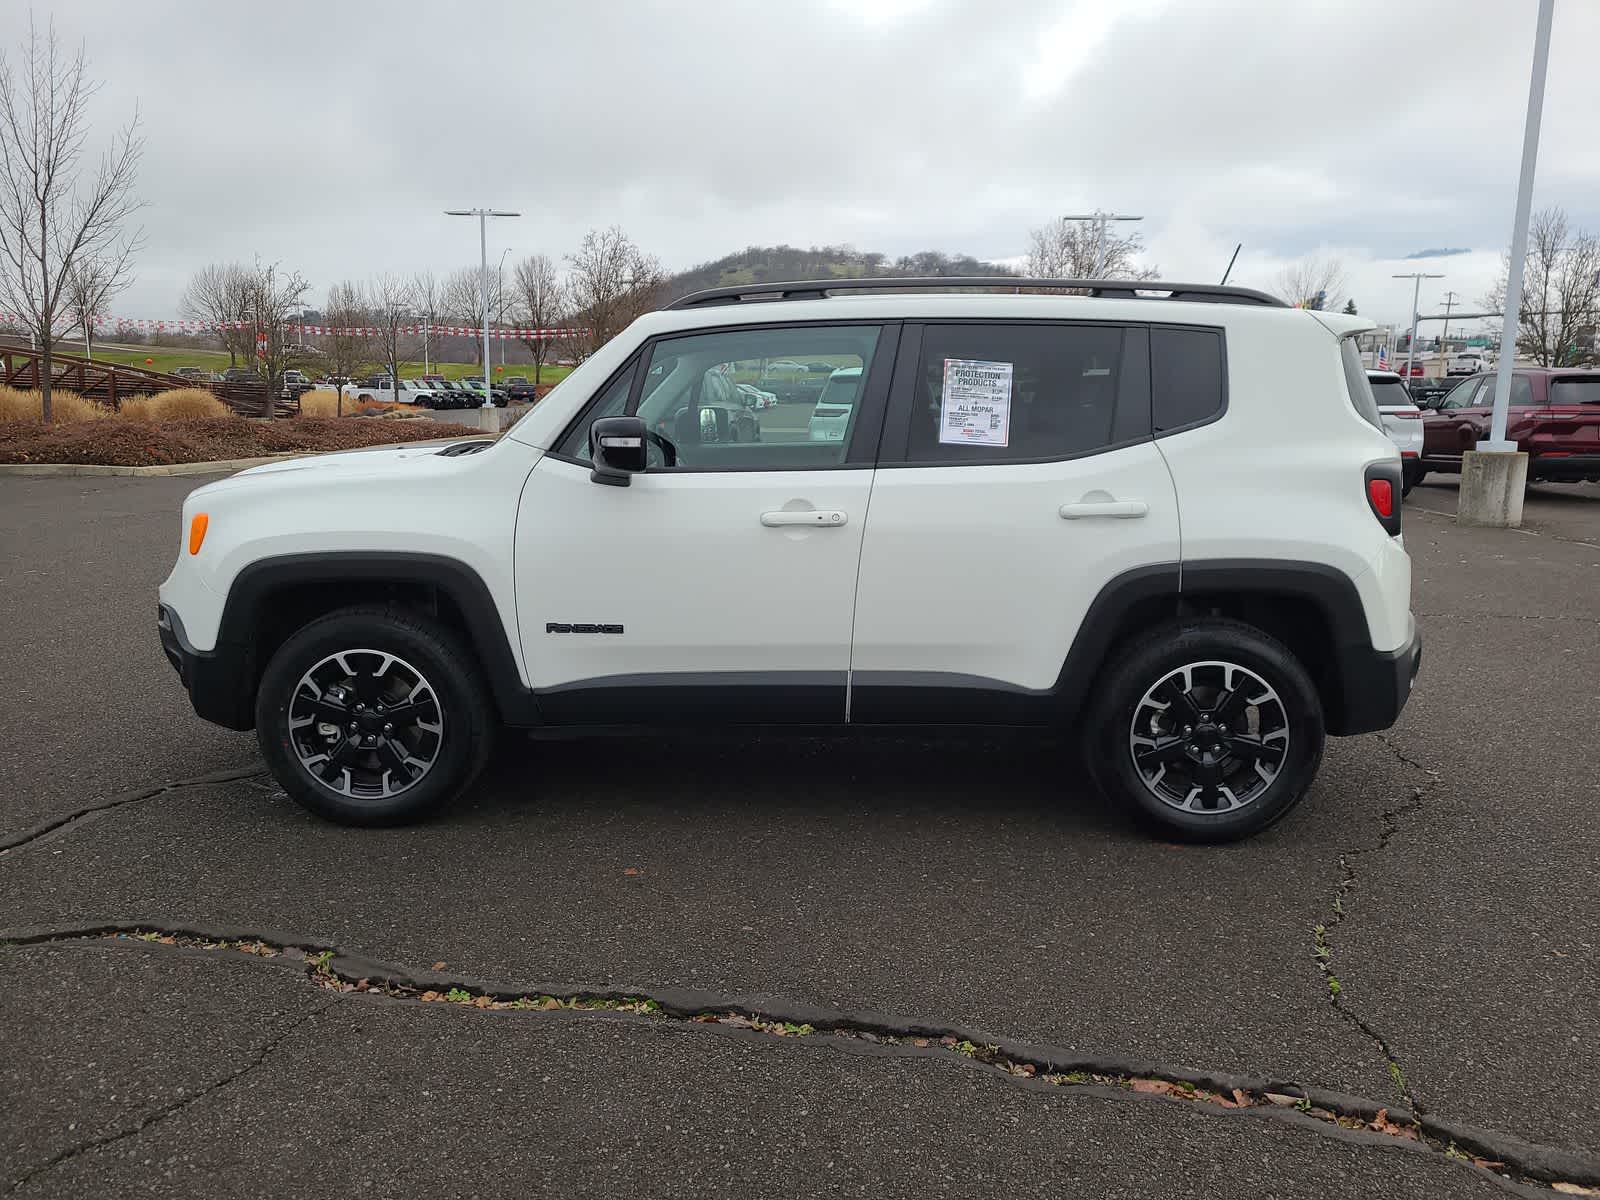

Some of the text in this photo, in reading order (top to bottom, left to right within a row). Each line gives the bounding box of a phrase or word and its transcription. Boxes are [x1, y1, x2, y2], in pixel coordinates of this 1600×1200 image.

[955, 369, 1001, 380] PROTECTION
[958, 377, 997, 387] PRODUCTS
[958, 404, 994, 413] ALL MOPAR
[546, 622, 624, 634] RENEGADE
